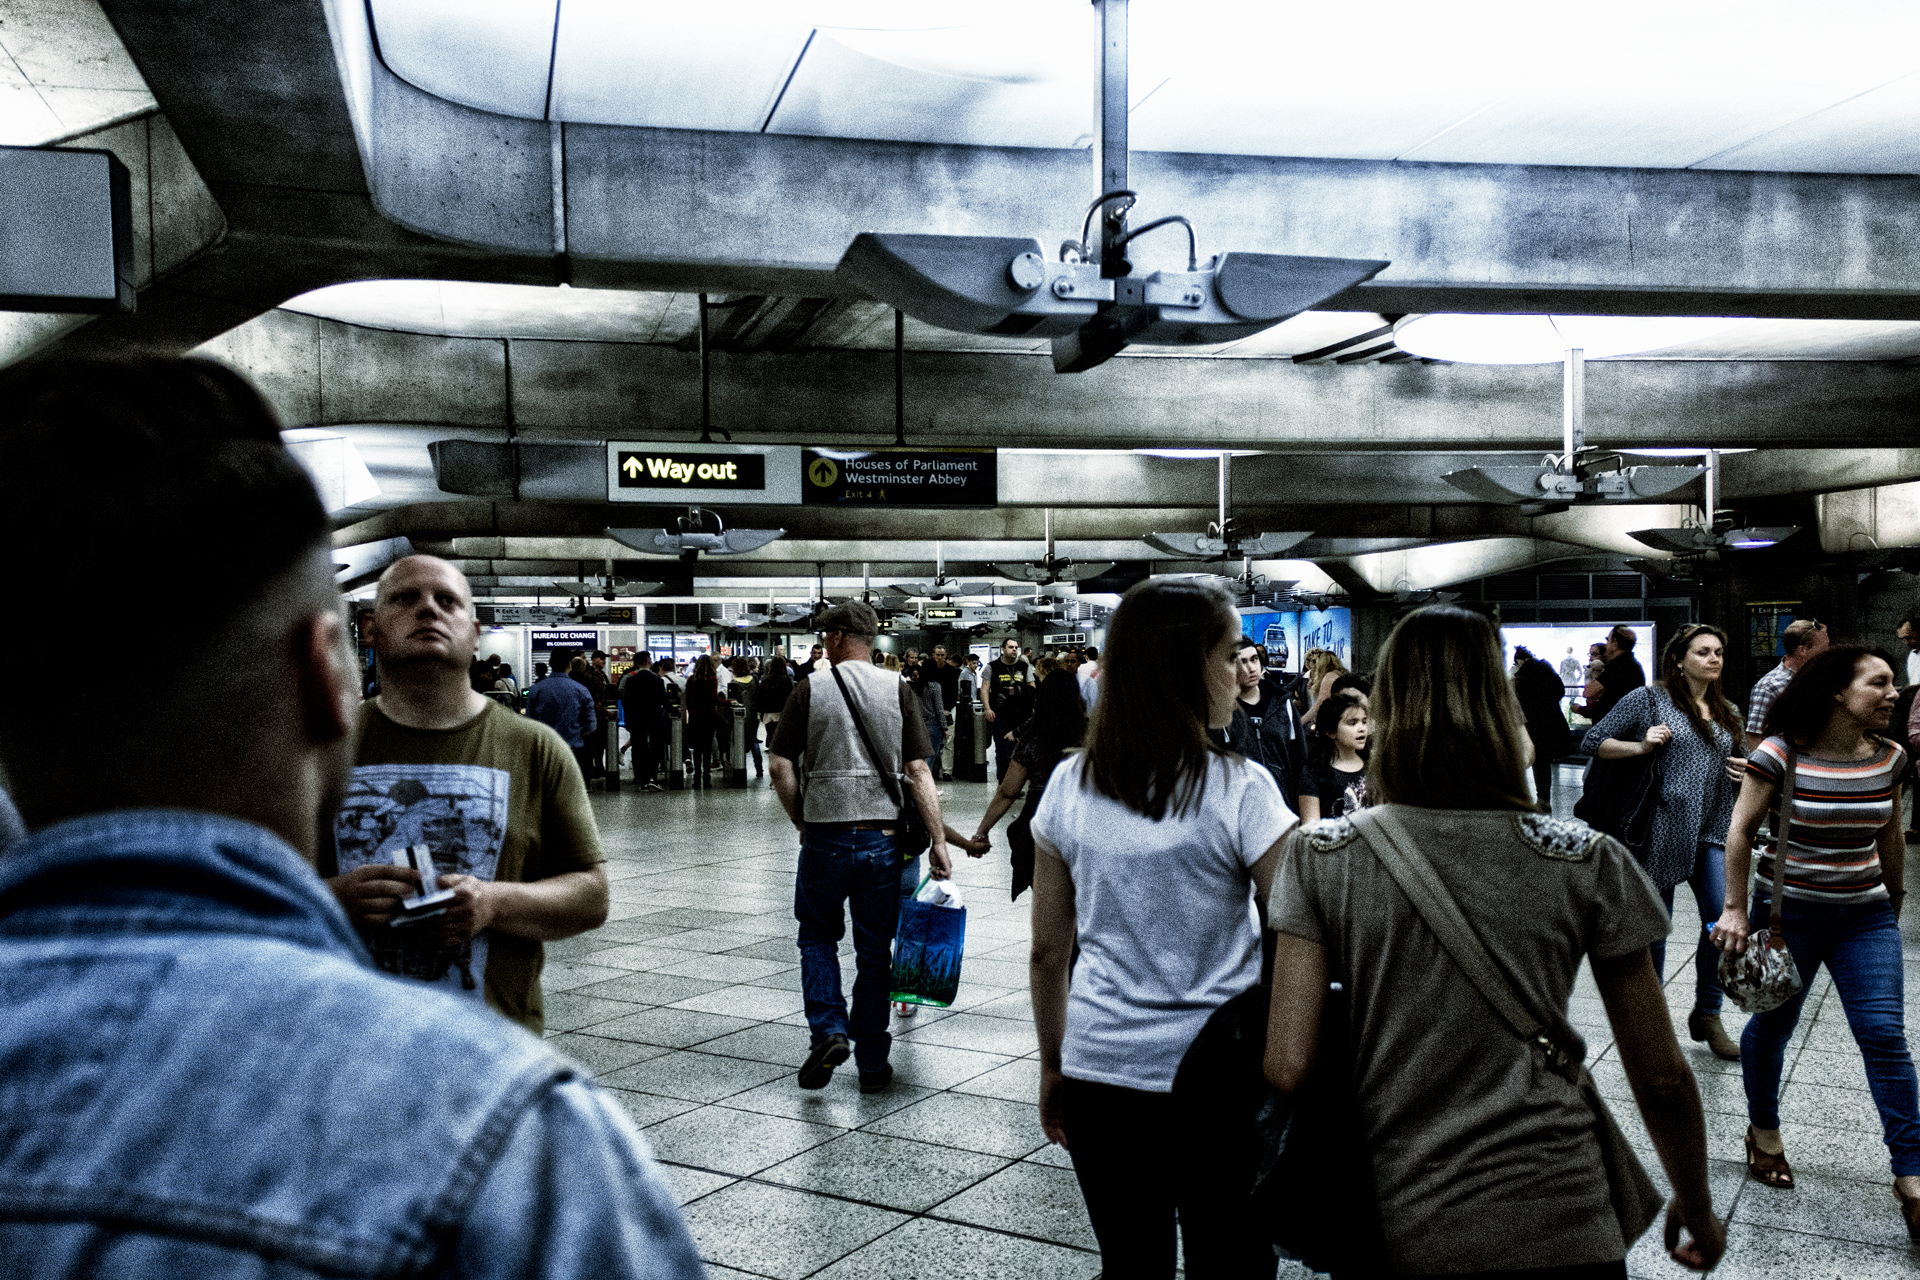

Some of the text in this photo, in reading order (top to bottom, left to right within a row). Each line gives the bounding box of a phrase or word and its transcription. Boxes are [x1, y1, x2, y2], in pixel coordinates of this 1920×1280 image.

[646, 458, 738, 483] Way out
[845, 459, 979, 471] Houses of Parliament
[845, 472, 967, 487] Westminster Abbey
[845, 490, 873, 498] Exit 4
[1304, 619, 1333, 655] TAKE TO
